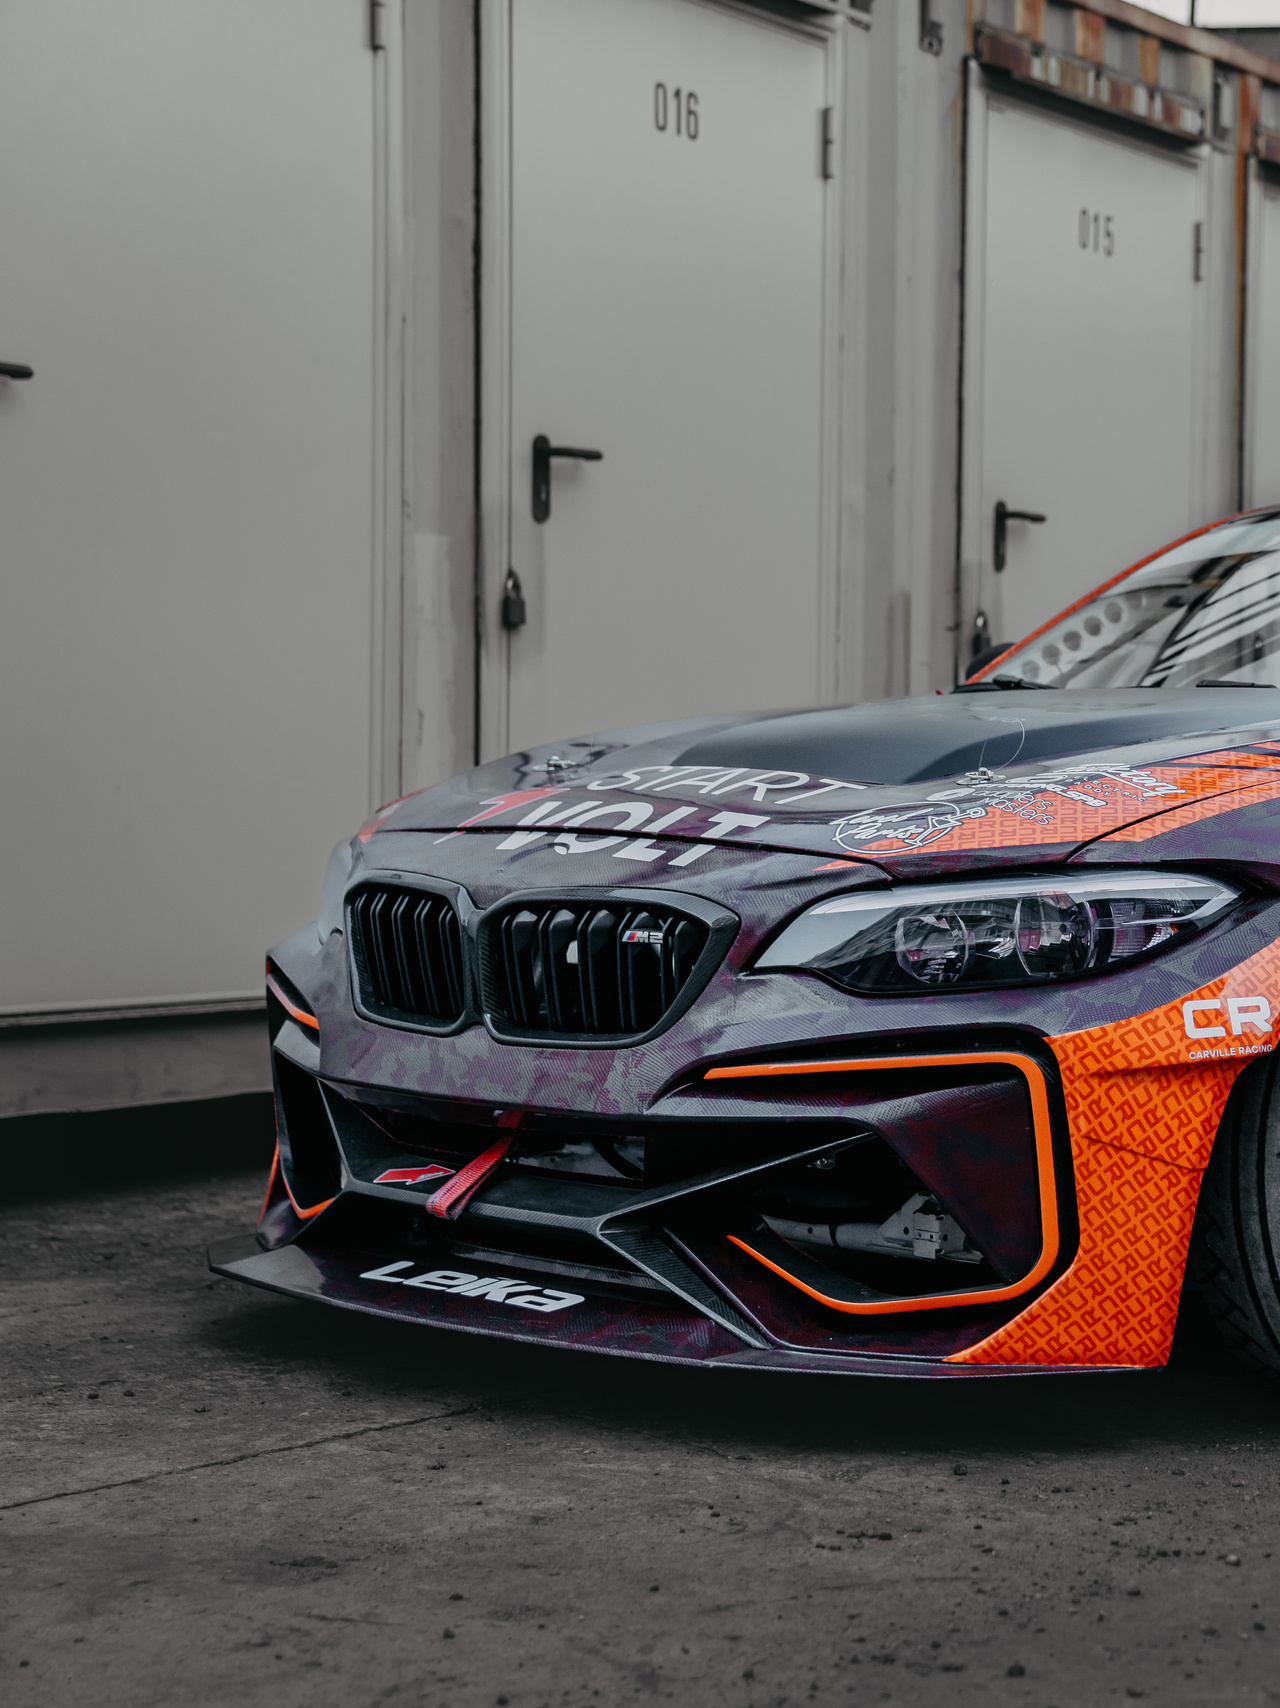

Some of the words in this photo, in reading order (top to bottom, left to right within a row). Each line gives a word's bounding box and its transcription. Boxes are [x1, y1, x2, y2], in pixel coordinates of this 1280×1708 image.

[654, 82, 699, 141] 016
[1078, 208, 1115, 257] 015
[587, 765, 867, 804] START
[496, 801, 771, 867] VOLT
[635, 930, 664, 944] M2
[1182, 996, 1273, 1039] CR
[1188, 1047, 1236, 1060] CARVILLE
[1238, 1044, 1273, 1055] RACING
